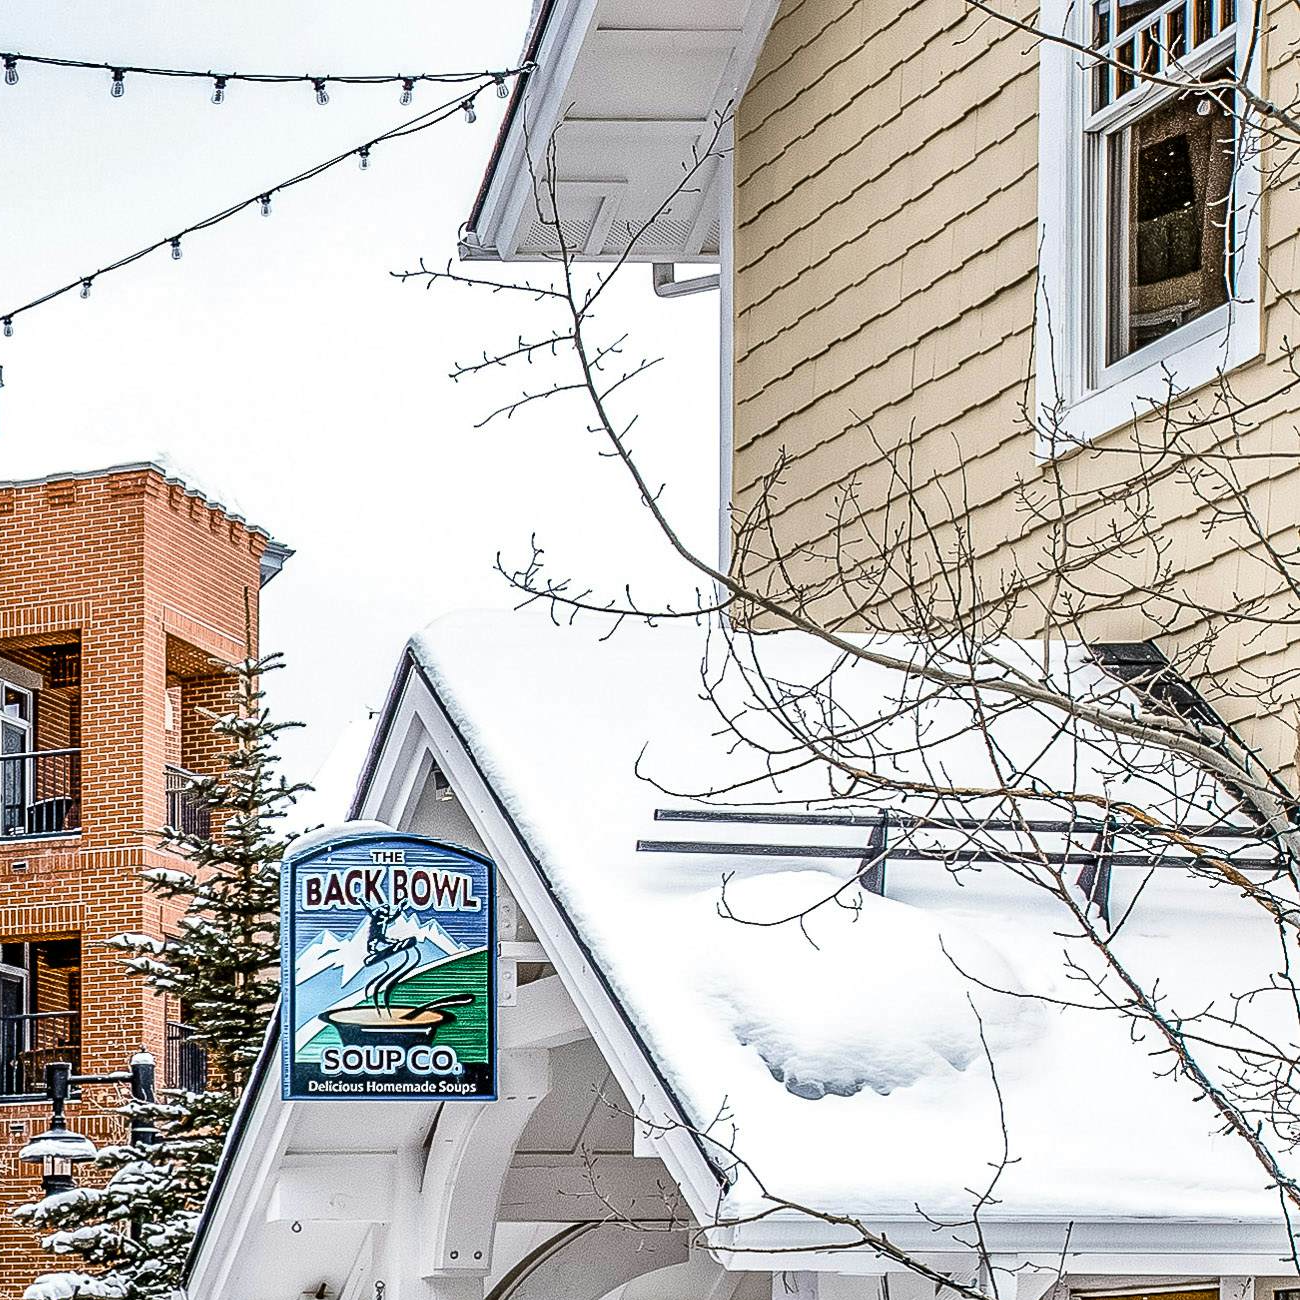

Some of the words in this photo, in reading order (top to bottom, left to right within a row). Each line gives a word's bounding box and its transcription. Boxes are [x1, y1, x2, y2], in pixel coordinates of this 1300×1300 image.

[372, 851, 403, 863] THE
[306, 870, 382, 907] BACK
[394, 870, 478, 908] BOWL
[324, 1050, 402, 1072] SOUP
[411, 1050, 460, 1072] CO.
[308, 1080, 364, 1093] Delicious
[367, 1080, 436, 1093] Homemade
[438, 1080, 477, 1095] Soups
